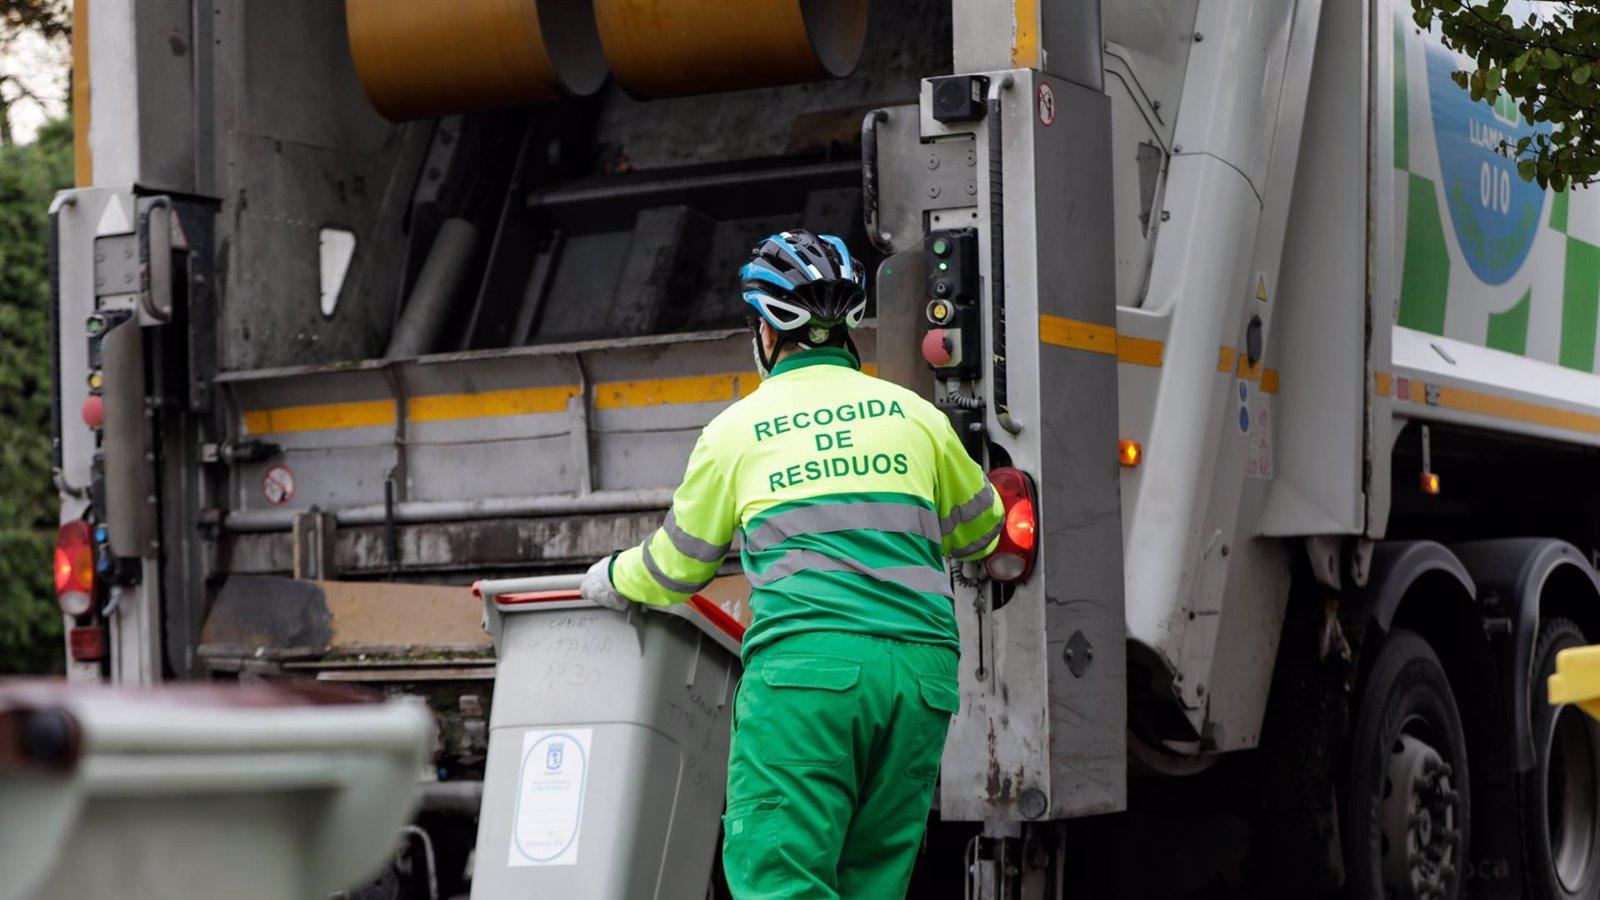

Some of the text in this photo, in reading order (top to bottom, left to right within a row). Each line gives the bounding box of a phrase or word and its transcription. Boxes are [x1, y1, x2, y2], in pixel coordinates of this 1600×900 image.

[1480, 161, 1511, 216] 010
[753, 398, 906, 442] RECOGIDA
[814, 430, 854, 452] DE
[768, 453, 909, 492] RESIDUOS
